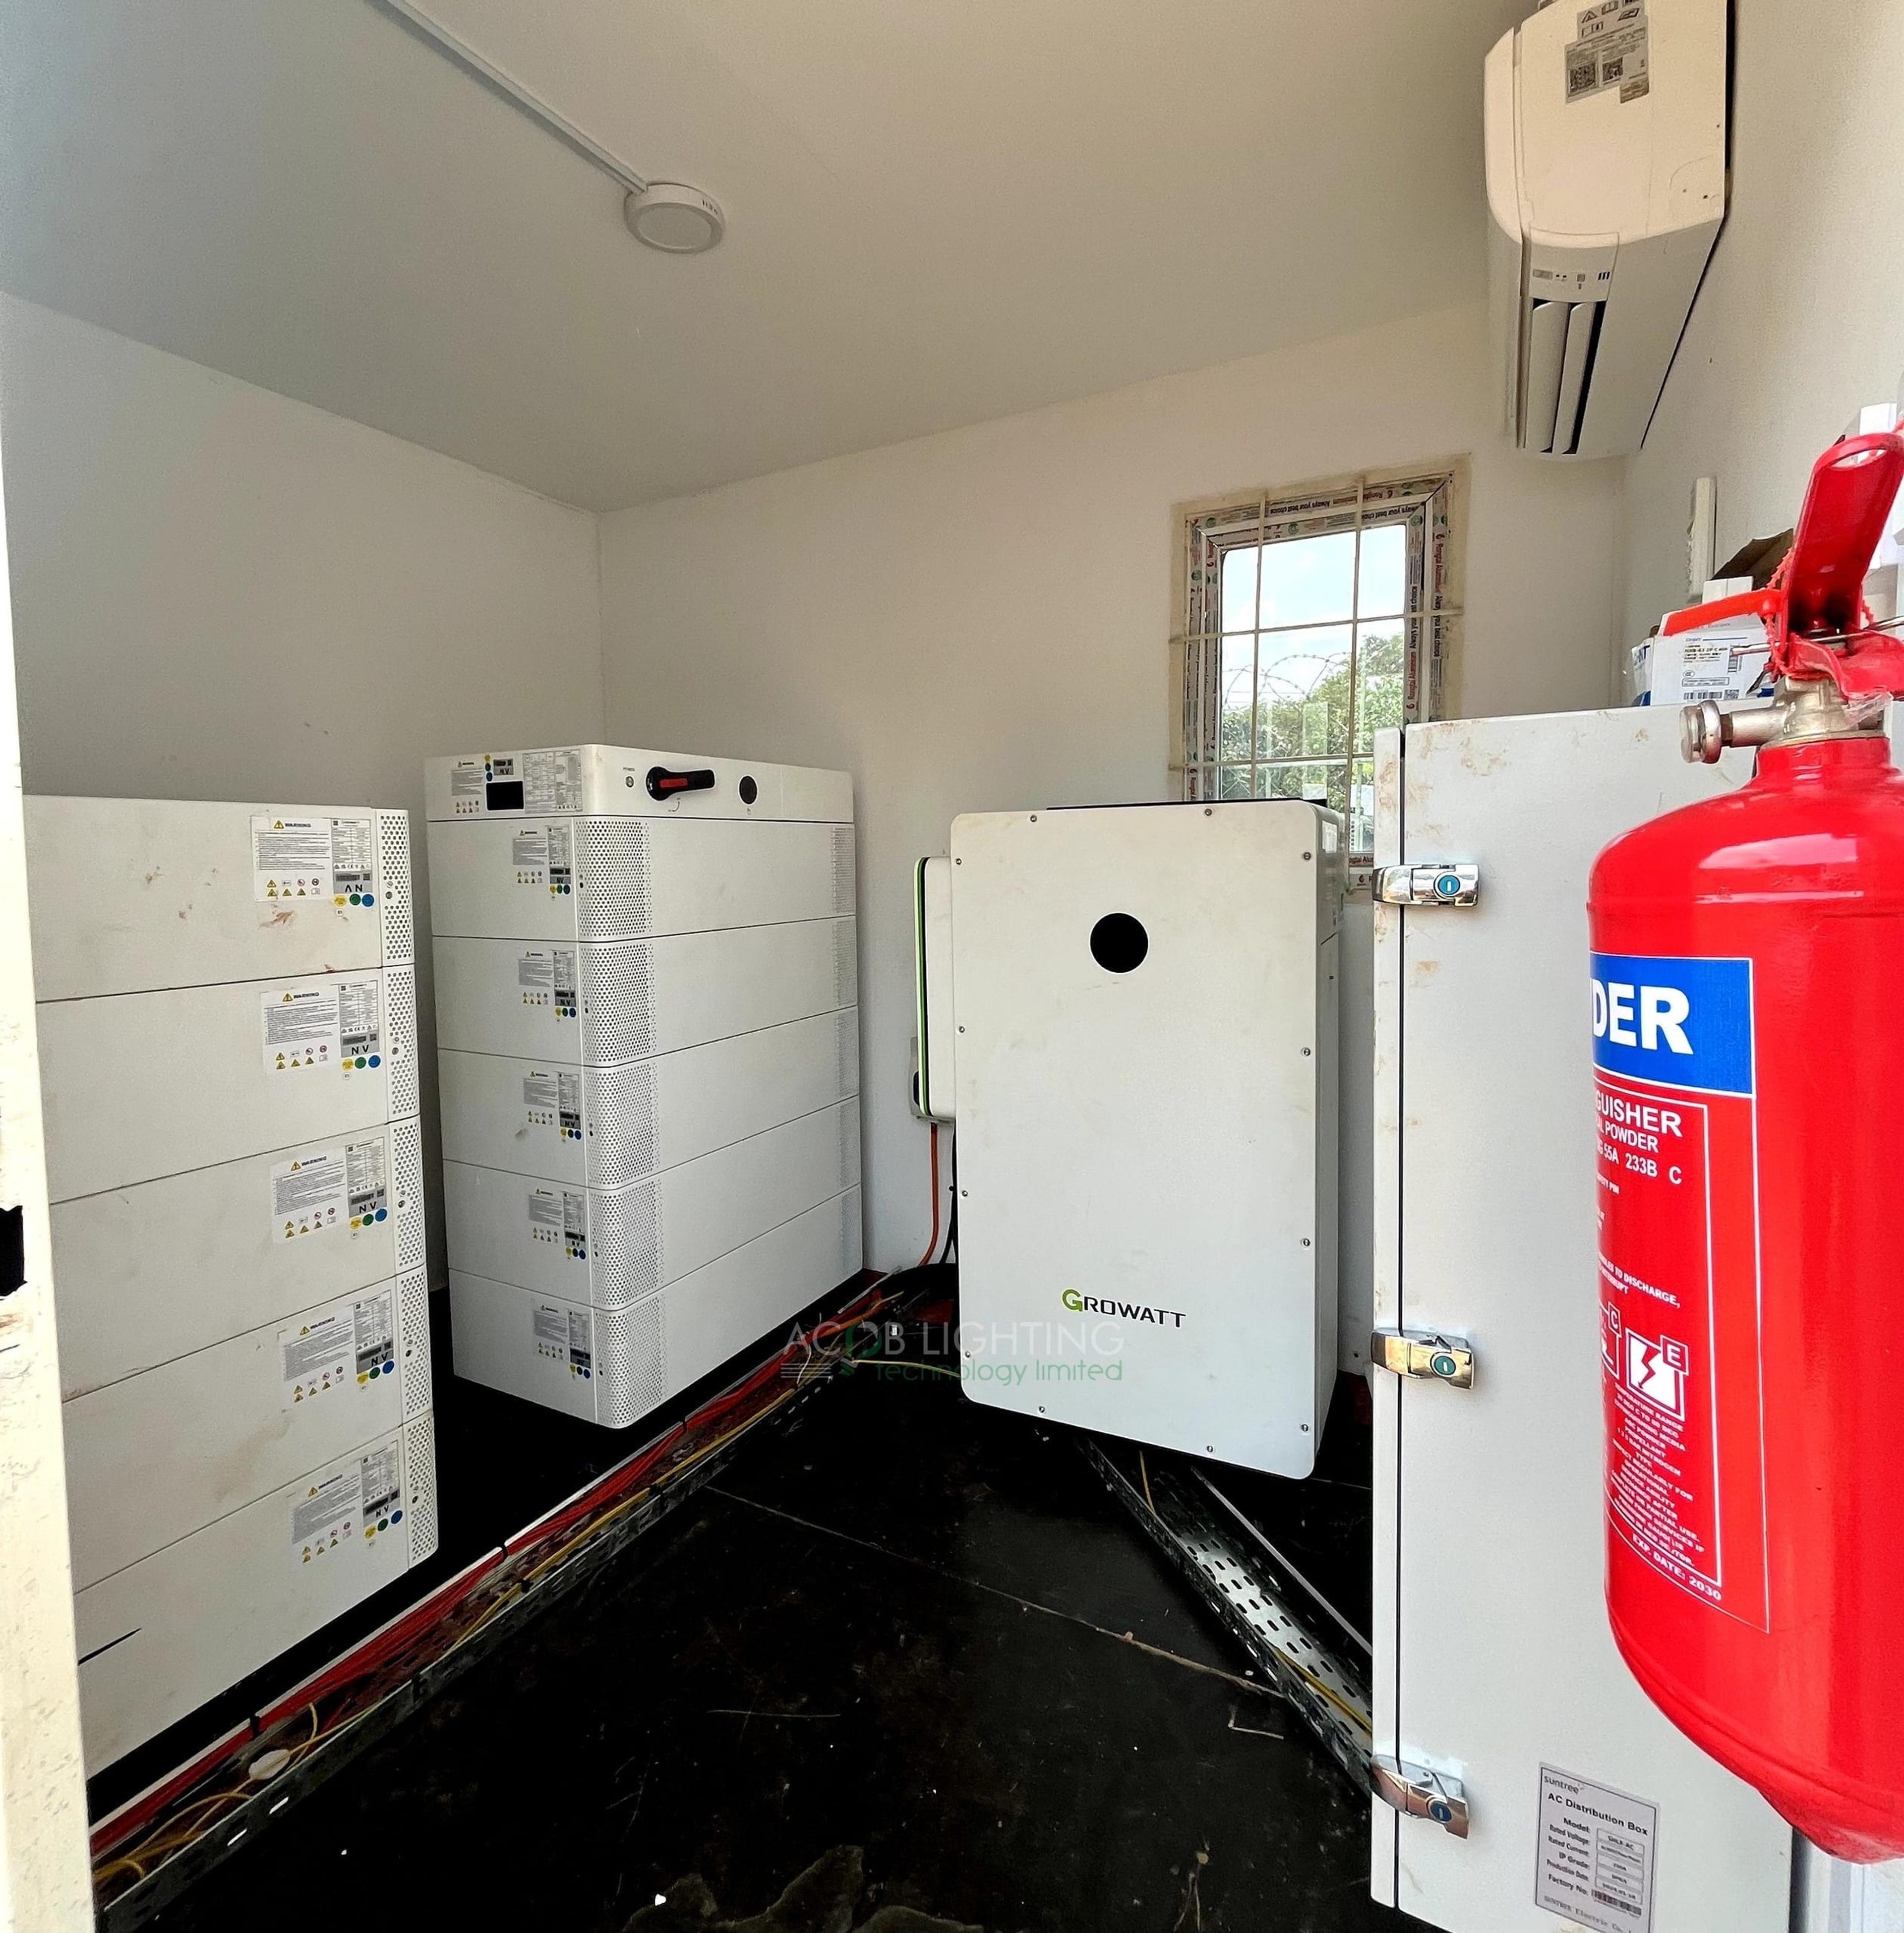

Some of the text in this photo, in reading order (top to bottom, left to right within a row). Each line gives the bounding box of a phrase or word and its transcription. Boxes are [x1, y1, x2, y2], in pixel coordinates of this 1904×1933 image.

[1433, 595, 1443, 610] Alway
[1591, 978, 1694, 1055] DER
[1596, 1090, 1682, 1137] GUISHER
[1606, 1121, 1659, 1153] POWDER
[1604, 1143, 1619, 1165] 55A
[1625, 1153, 1658, 1177] 233B
[1669, 1166, 1682, 1184] C
[1615, 1266, 1622, 1279] TO
[1624, 1273, 1680, 1309] DISCHARGE,
[1062, 1289, 1186, 1328] GROWATT
[1611, 1310, 1618, 1329] C
[1666, 1343, 1682, 1367] E
[1655, 1412, 1683, 1432] RANGE
[1659, 1432, 1686, 1452] MEDIA
[1636, 1451, 1652, 1468] TYPE
[1642, 1448, 1681, 1476] NITROGEN
[1646, 1486, 1675, 1508] ABILITY
[1675, 1487, 1693, 1501] FOR
[1646, 1503, 1678, 1529] PARTIAL
[1653, 1500, 1678, 1520] AFTER
[1653, 1518, 1693, 1547] SERVICES
[1633, 1533, 1722, 1601] EXP. DATE: 2030
[1544, 1776, 1579, 1795] suntree
[1548, 1793, 1649, 1835] AC Distribution Box
[1548, 1874, 1574, 1890] Factory
